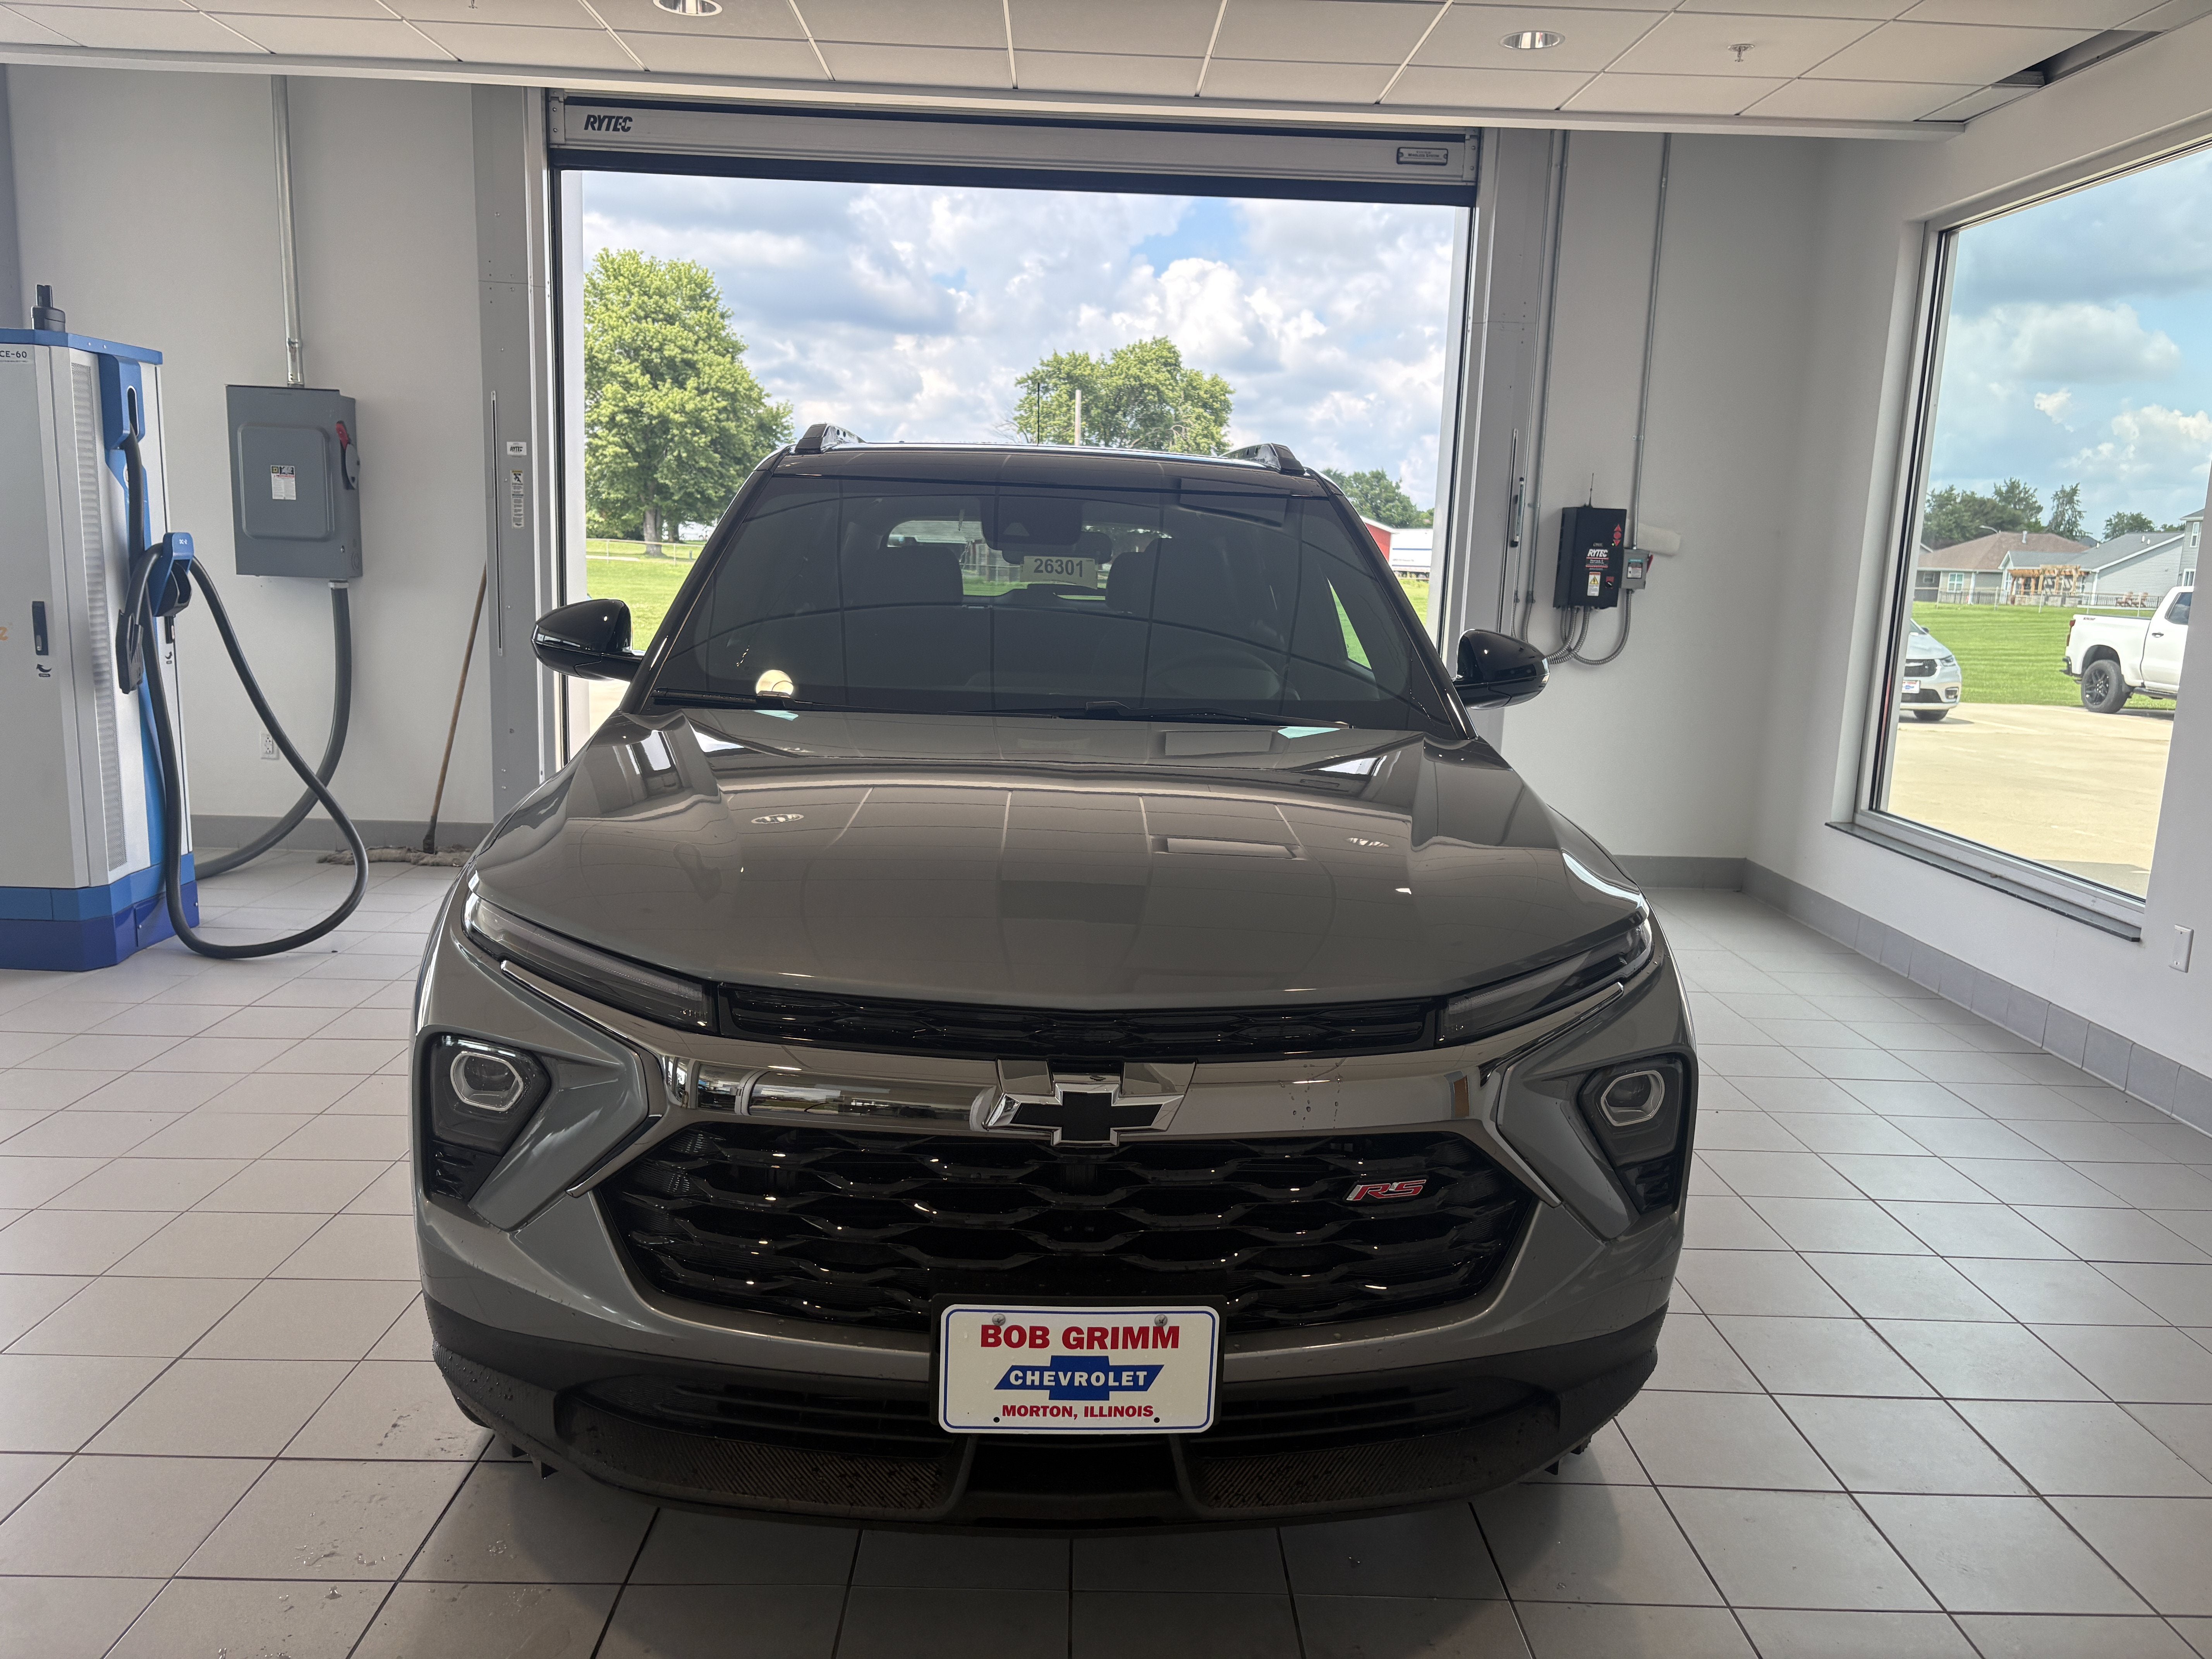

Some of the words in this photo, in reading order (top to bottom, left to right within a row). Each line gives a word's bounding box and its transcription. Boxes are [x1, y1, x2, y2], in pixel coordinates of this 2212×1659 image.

[584, 114, 633, 132] RYTEC
[1587, 549, 1608, 557] RYTEC
[1034, 558, 1083, 577] 26301
[1346, 1179, 1427, 1200] RS
[981, 1324, 1050, 1348] BOB
[1062, 1326, 1180, 1350] GRIMM
[1009, 1370, 1148, 1387] CHEVROLET
[1002, 1405, 1078, 1420] MORTON,
[1084, 1405, 1154, 1418] ILLINOIS
